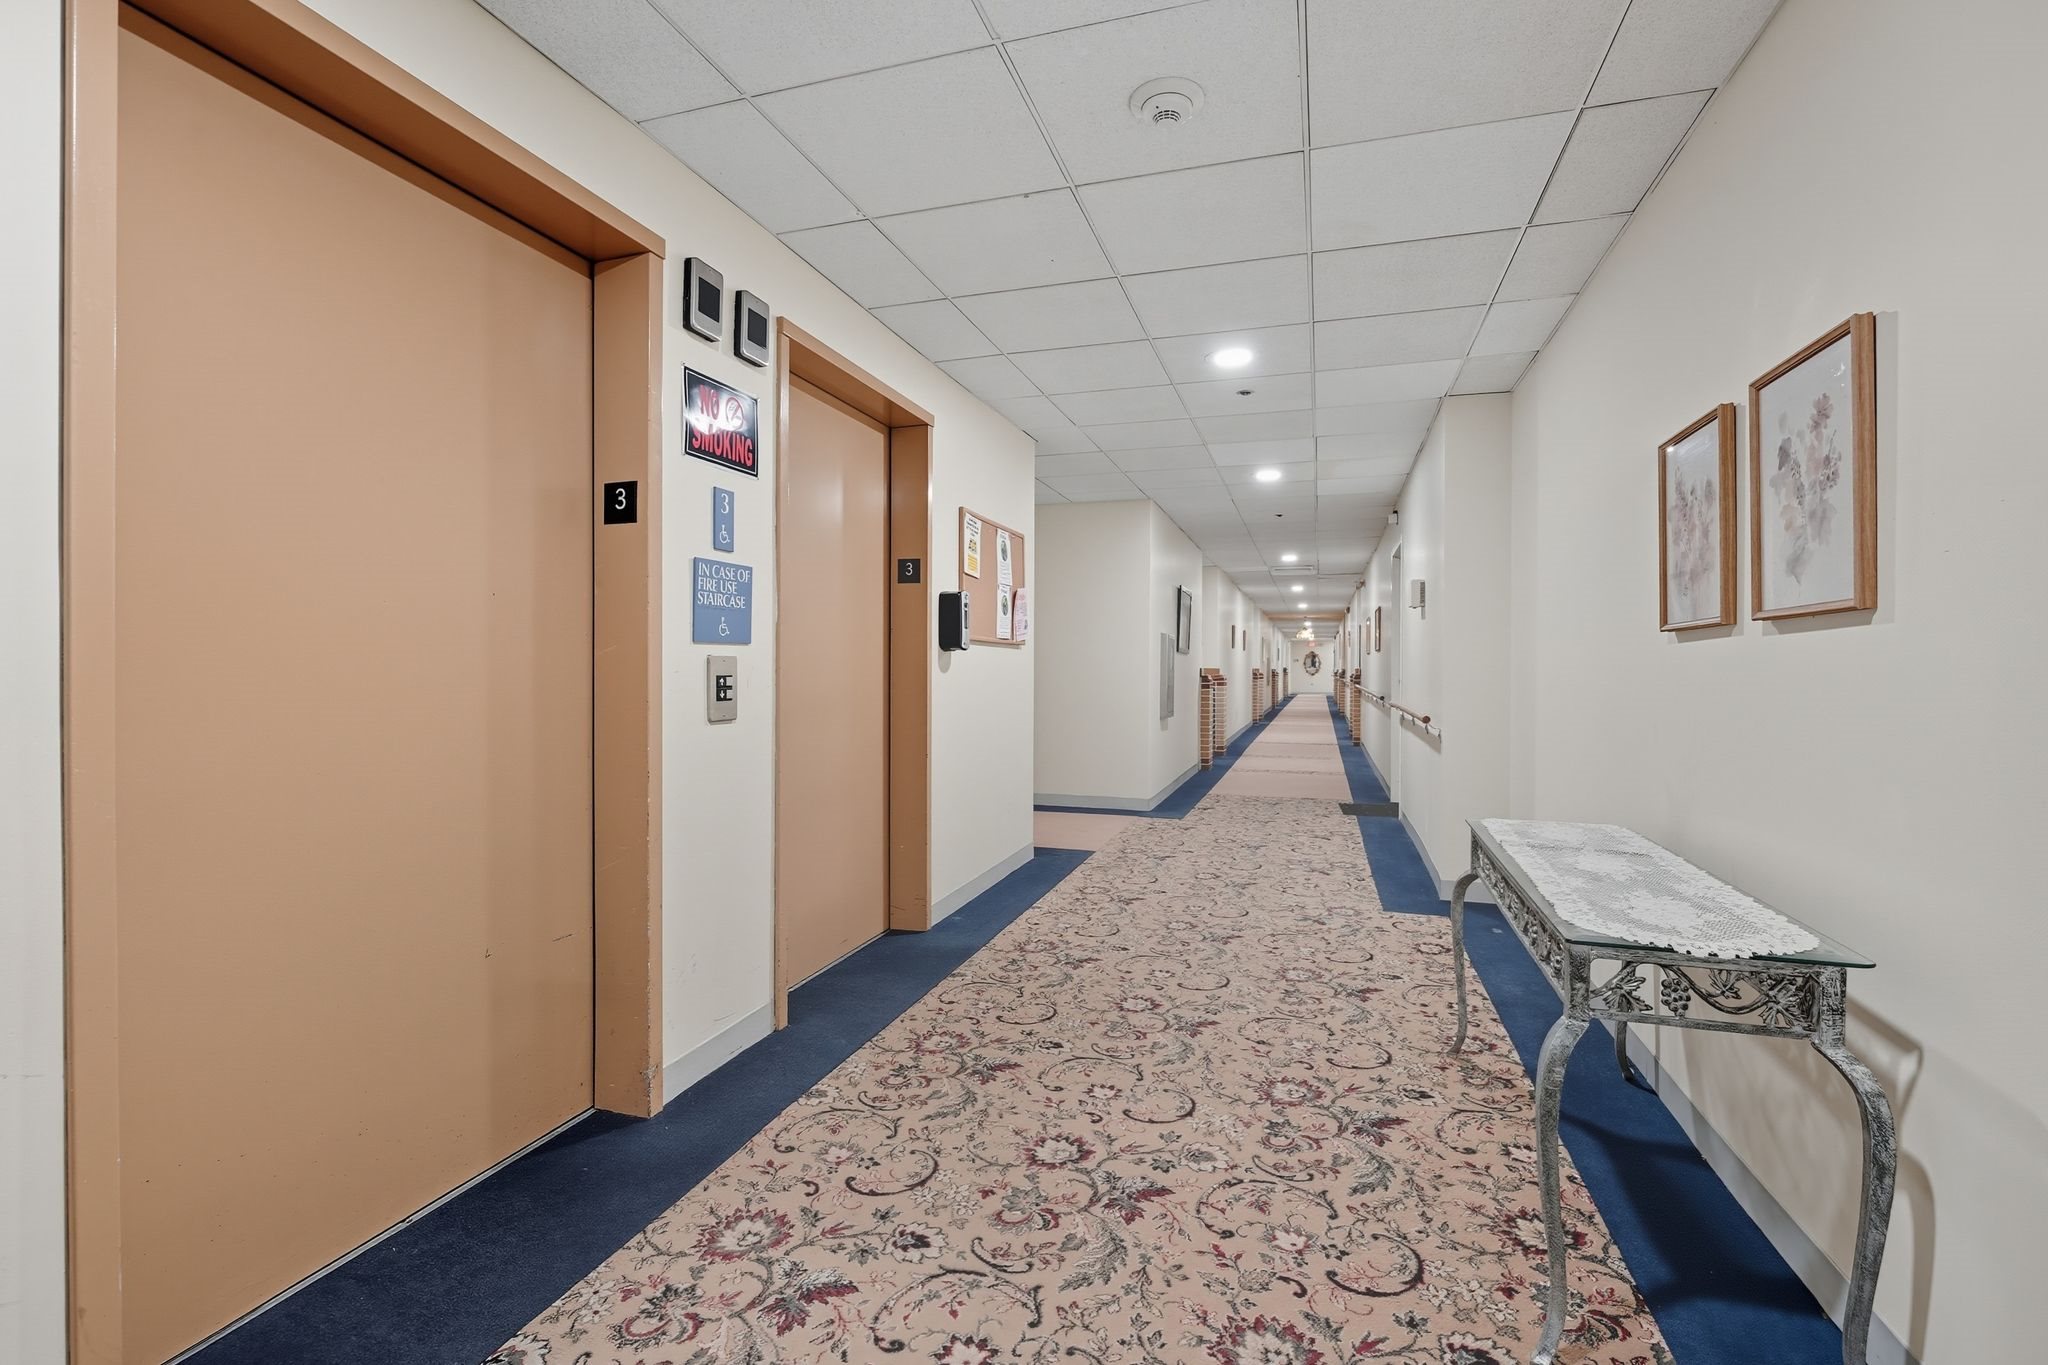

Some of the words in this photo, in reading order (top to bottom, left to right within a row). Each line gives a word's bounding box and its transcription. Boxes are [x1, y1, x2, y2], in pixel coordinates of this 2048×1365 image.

[698, 384, 720, 420] NO
[692, 423, 753, 467] SMOKING
[615, 488, 626, 510] 3
[720, 493, 729, 514] 3
[698, 561, 710, 577] IN
[712, 564, 736, 580] CASE
[737, 568, 751, 583] OF
[905, 562, 913, 575] 3
[698, 576, 718, 592] FIRE
[720, 580, 738, 594] USE
[697, 591, 746, 609] STAIRCASE
